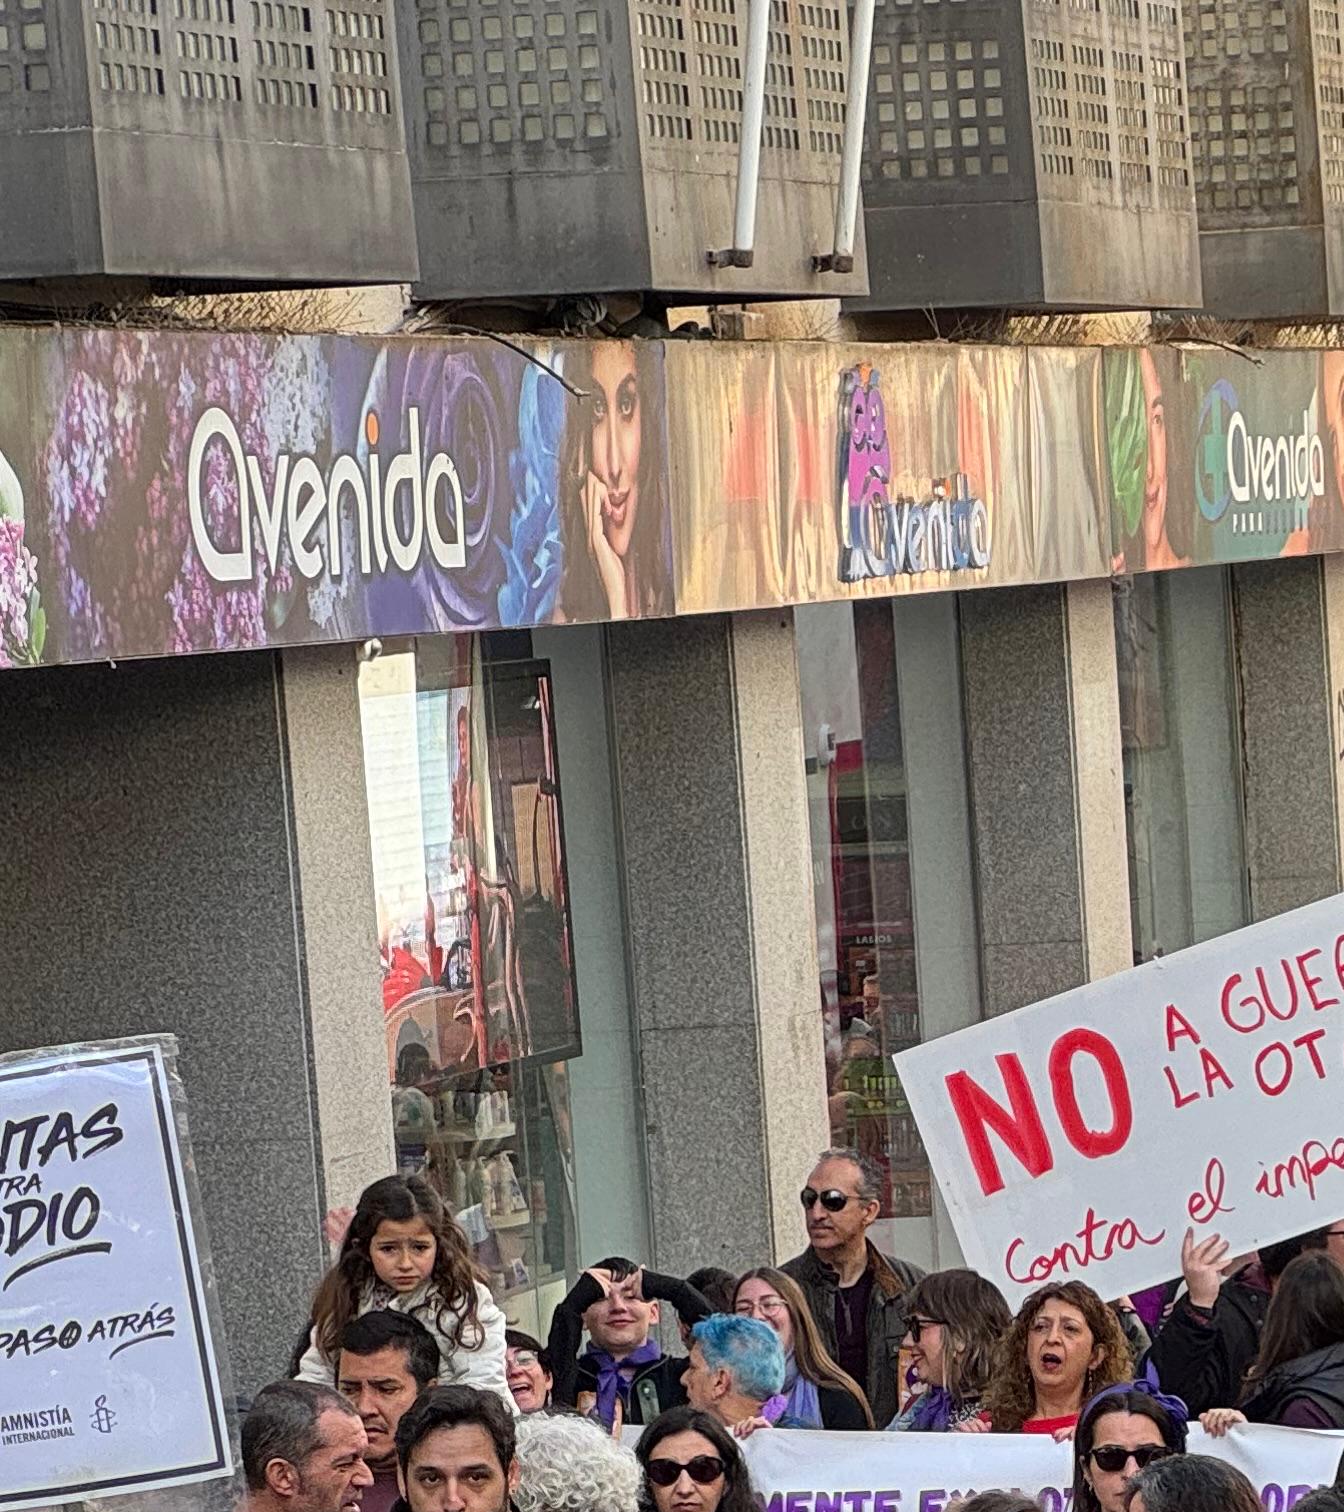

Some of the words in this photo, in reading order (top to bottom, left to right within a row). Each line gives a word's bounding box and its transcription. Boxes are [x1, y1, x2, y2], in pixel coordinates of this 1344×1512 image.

[944, 1027, 1133, 1197] NO
[1163, 1004, 1201, 1052] A
[1163, 1048, 1234, 1108] LA
[0, 1186, 101, 1256] DIO
[1187, 1157, 1235, 1225] el
[87, 1302, 176, 1343] ATRÁS
[0, 1404, 72, 1432] AMNISTÍA
[1, 1428, 76, 1446] INTERNACIONAL
